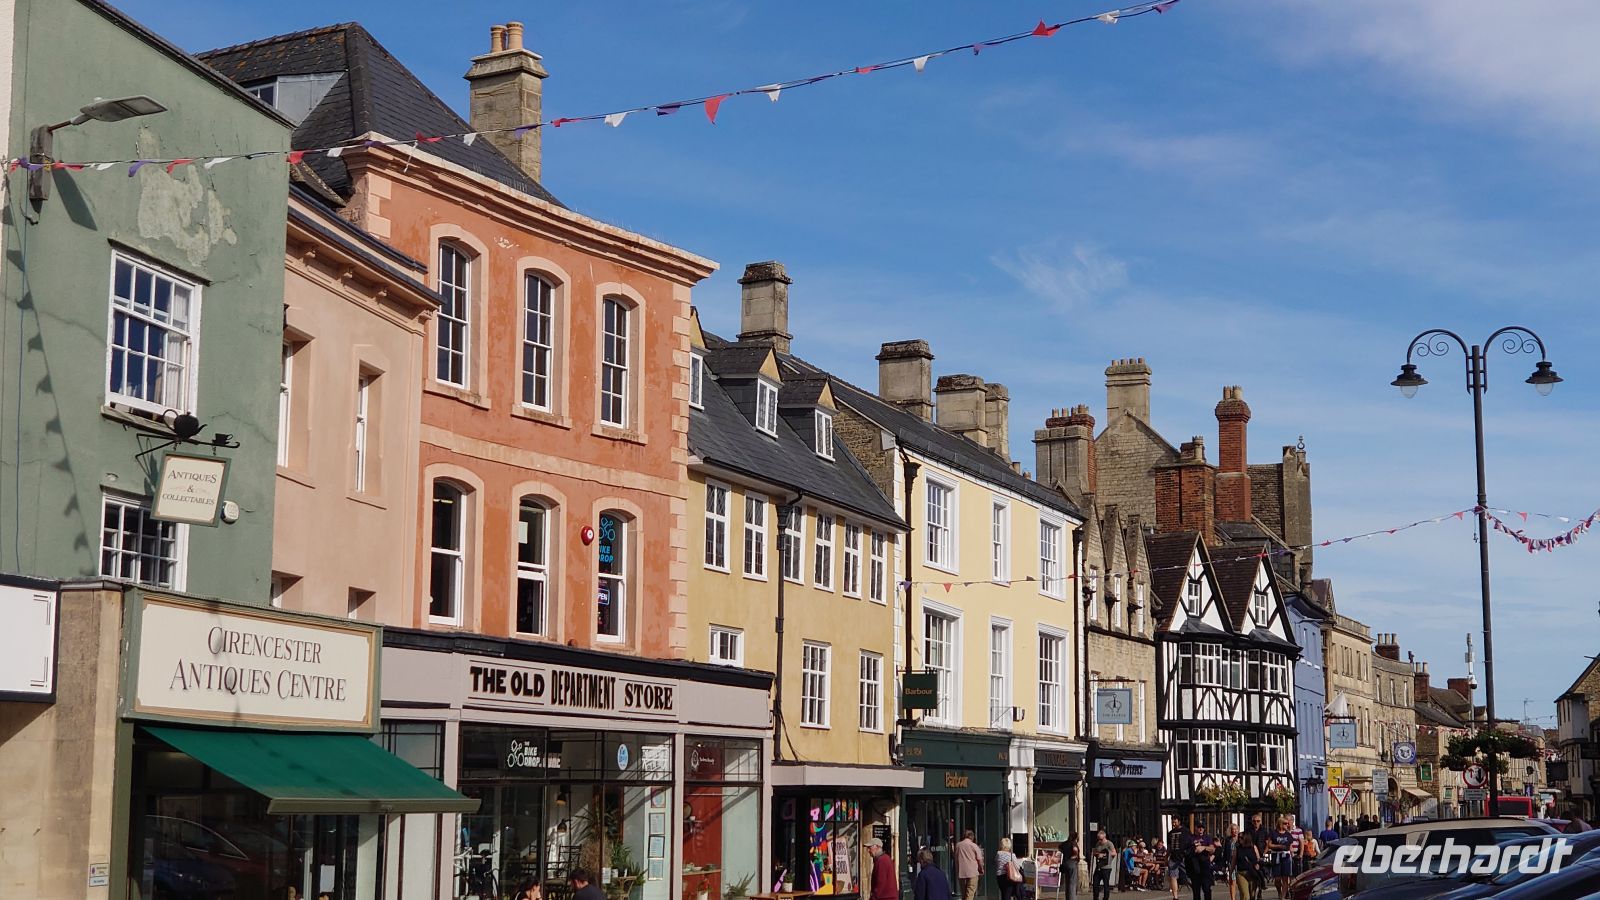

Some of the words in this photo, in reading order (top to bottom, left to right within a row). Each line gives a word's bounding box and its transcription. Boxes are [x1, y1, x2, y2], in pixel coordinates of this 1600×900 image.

[168, 470, 217, 484] ANTIQUES
[187, 485, 194, 493] &
[162, 494, 215, 505] COLLECTABLES
[207, 626, 322, 664] CIRENCESTER
[169, 658, 272, 695] ANTIQUES
[277, 669, 347, 701] CENTRE
[470, 666, 507, 694] THE
[510, 671, 545, 697] OLD
[551, 669, 616, 710] DEPARTMENT
[624, 683, 673, 711] STORE
[905, 687, 933, 695] Barbour
[524, 746, 538, 756] BIKE
[945, 771, 968, 788] Barbour
